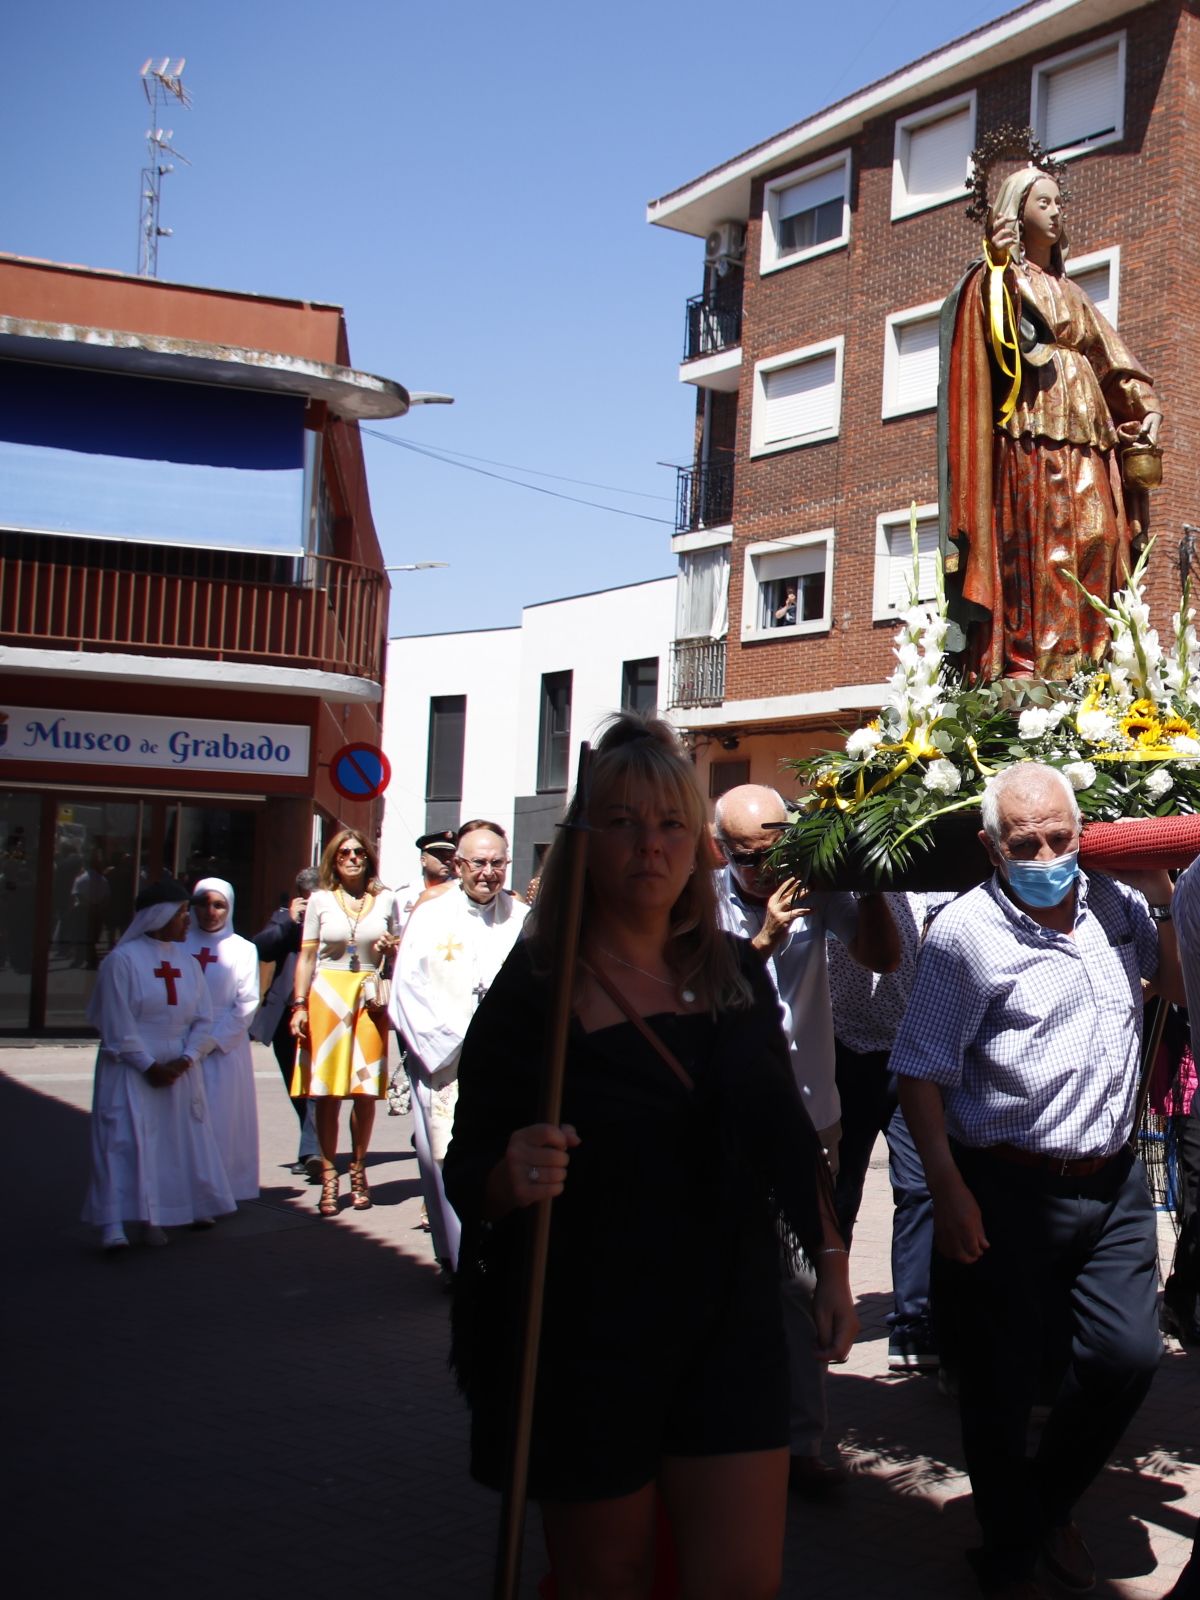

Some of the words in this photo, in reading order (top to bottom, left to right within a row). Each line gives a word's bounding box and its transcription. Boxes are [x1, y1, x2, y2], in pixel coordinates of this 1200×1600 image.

[23, 717, 131, 752] Museo
[139, 739, 159, 754] de
[168, 731, 291, 763] Grabado
